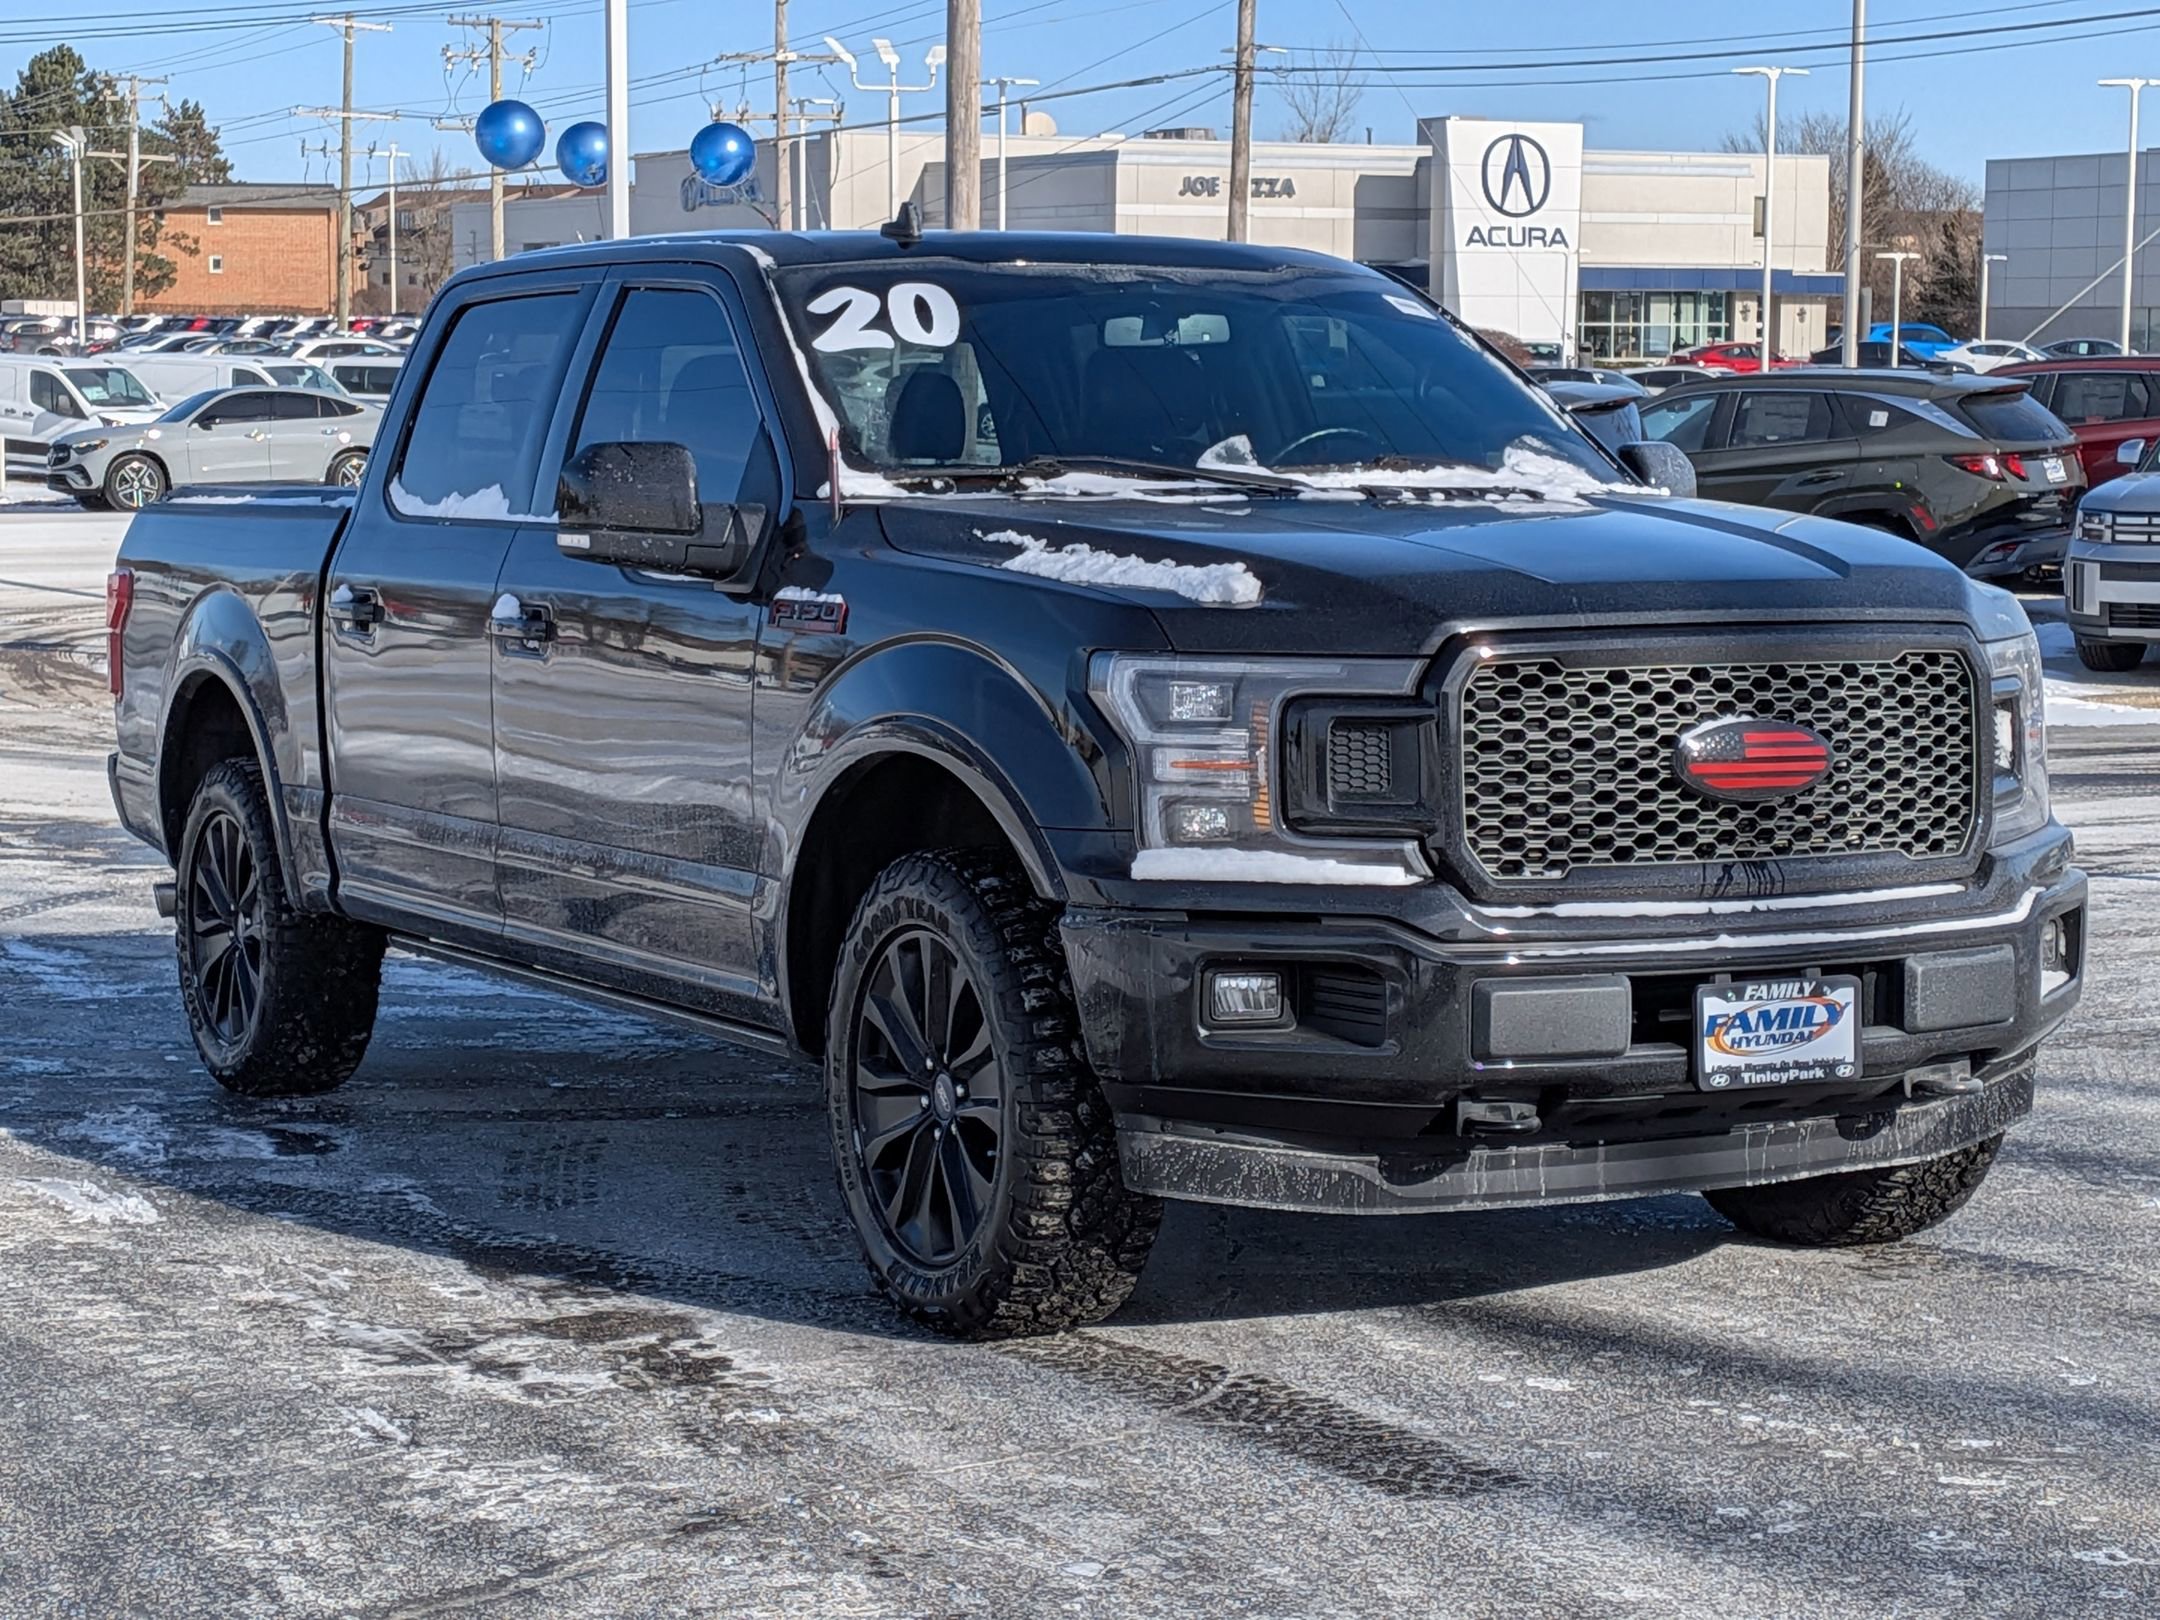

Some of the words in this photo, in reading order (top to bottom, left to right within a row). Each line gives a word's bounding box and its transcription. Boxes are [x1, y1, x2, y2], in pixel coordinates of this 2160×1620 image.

[1178, 176, 1220, 198] JOE
[1250, 177, 1297, 199] ZZA
[1465, 225, 1569, 249] ACURA
[806, 283, 960, 353] 20
[853, 896, 950, 966] GOODYEAR
[1744, 981, 1817, 1001] FAMILY
[1704, 1001, 1852, 1038] FAMILY
[1729, 1030, 1816, 1050] HYUNDAI
